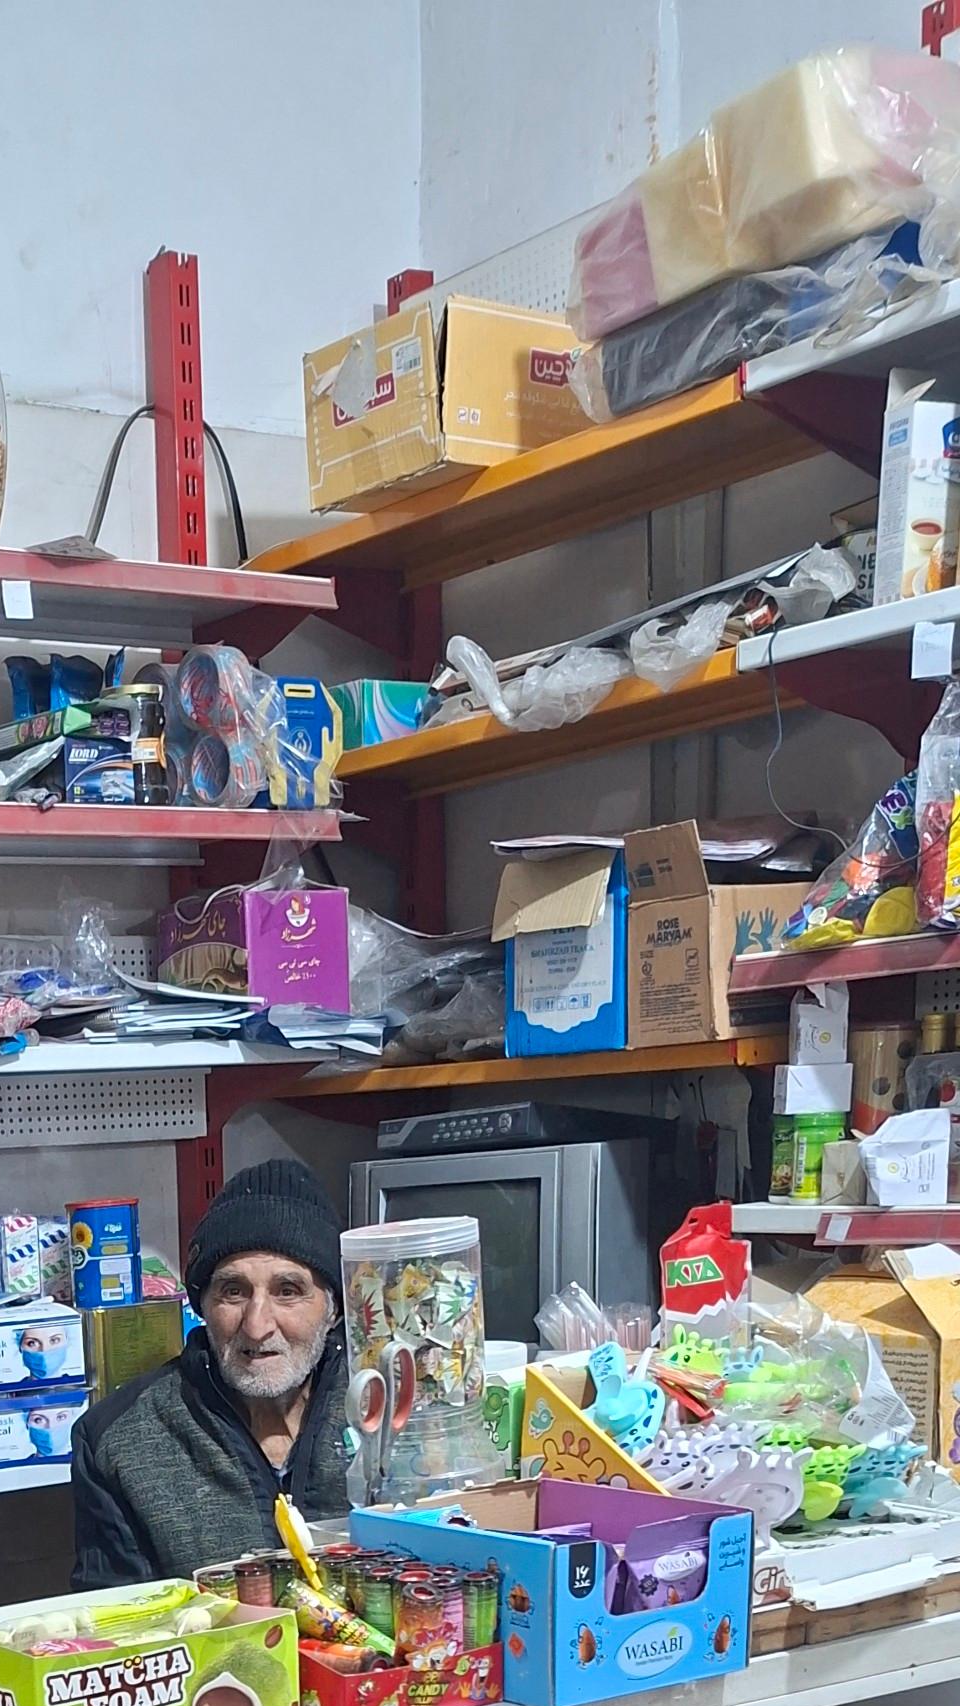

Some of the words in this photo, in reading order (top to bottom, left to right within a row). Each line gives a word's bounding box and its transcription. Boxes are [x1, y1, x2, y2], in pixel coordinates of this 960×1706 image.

[281, 918, 317, 943] شهرزاد
[657, 917, 680, 930] ROSE
[646, 927, 693, 945] MARYAM
[658, 1554, 699, 1573] WASABI
[575, 1566, 589, 1581] ۱۶
[573, 1580, 592, 1590] عدد
[624, 1635, 684, 1662] WASABI
[47, 1646, 190, 1706] MATCHA
[408, 1683, 448, 1697] CANDY
